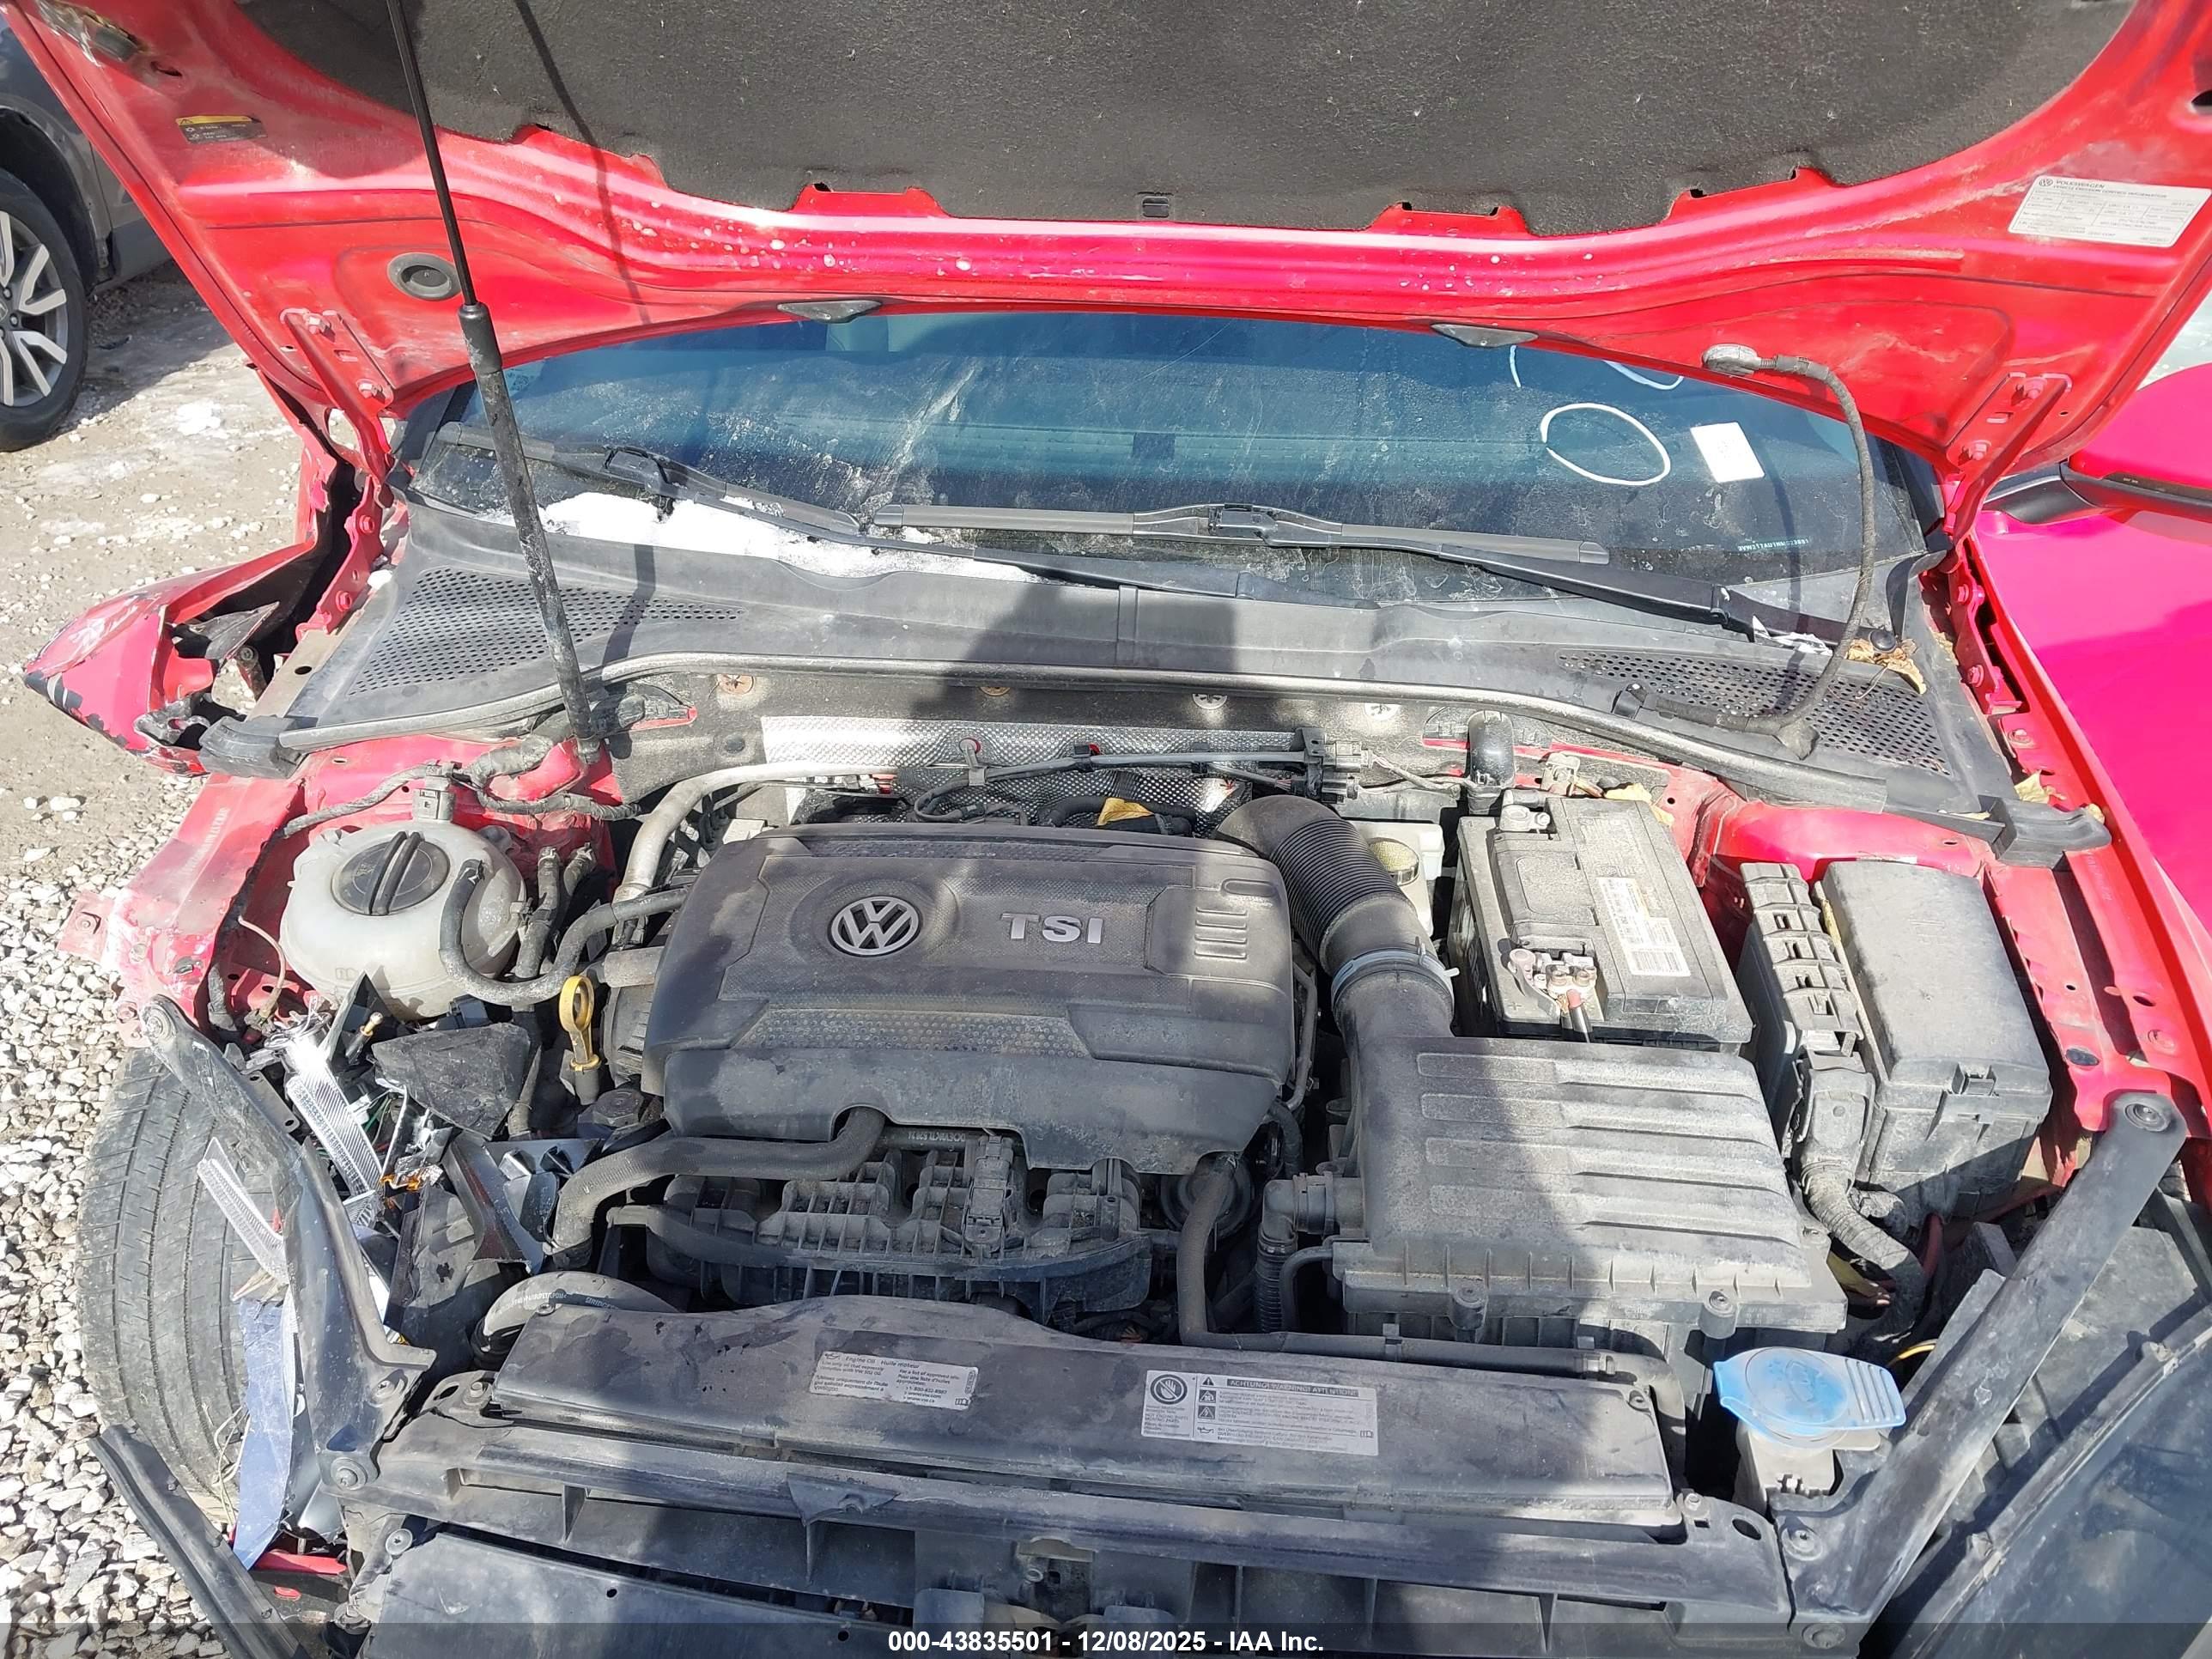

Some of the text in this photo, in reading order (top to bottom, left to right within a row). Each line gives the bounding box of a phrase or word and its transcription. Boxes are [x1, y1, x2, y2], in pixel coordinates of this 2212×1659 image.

[2055, 179, 2106, 189] VOLKSWAGEN
[1001, 913, 1104, 944] TSI
[896, 1360, 920, 1369] moteur
[1230, 1379, 1269, 1389] ACHTUNG!
[1269, 1382, 1310, 1393] WARNING!
